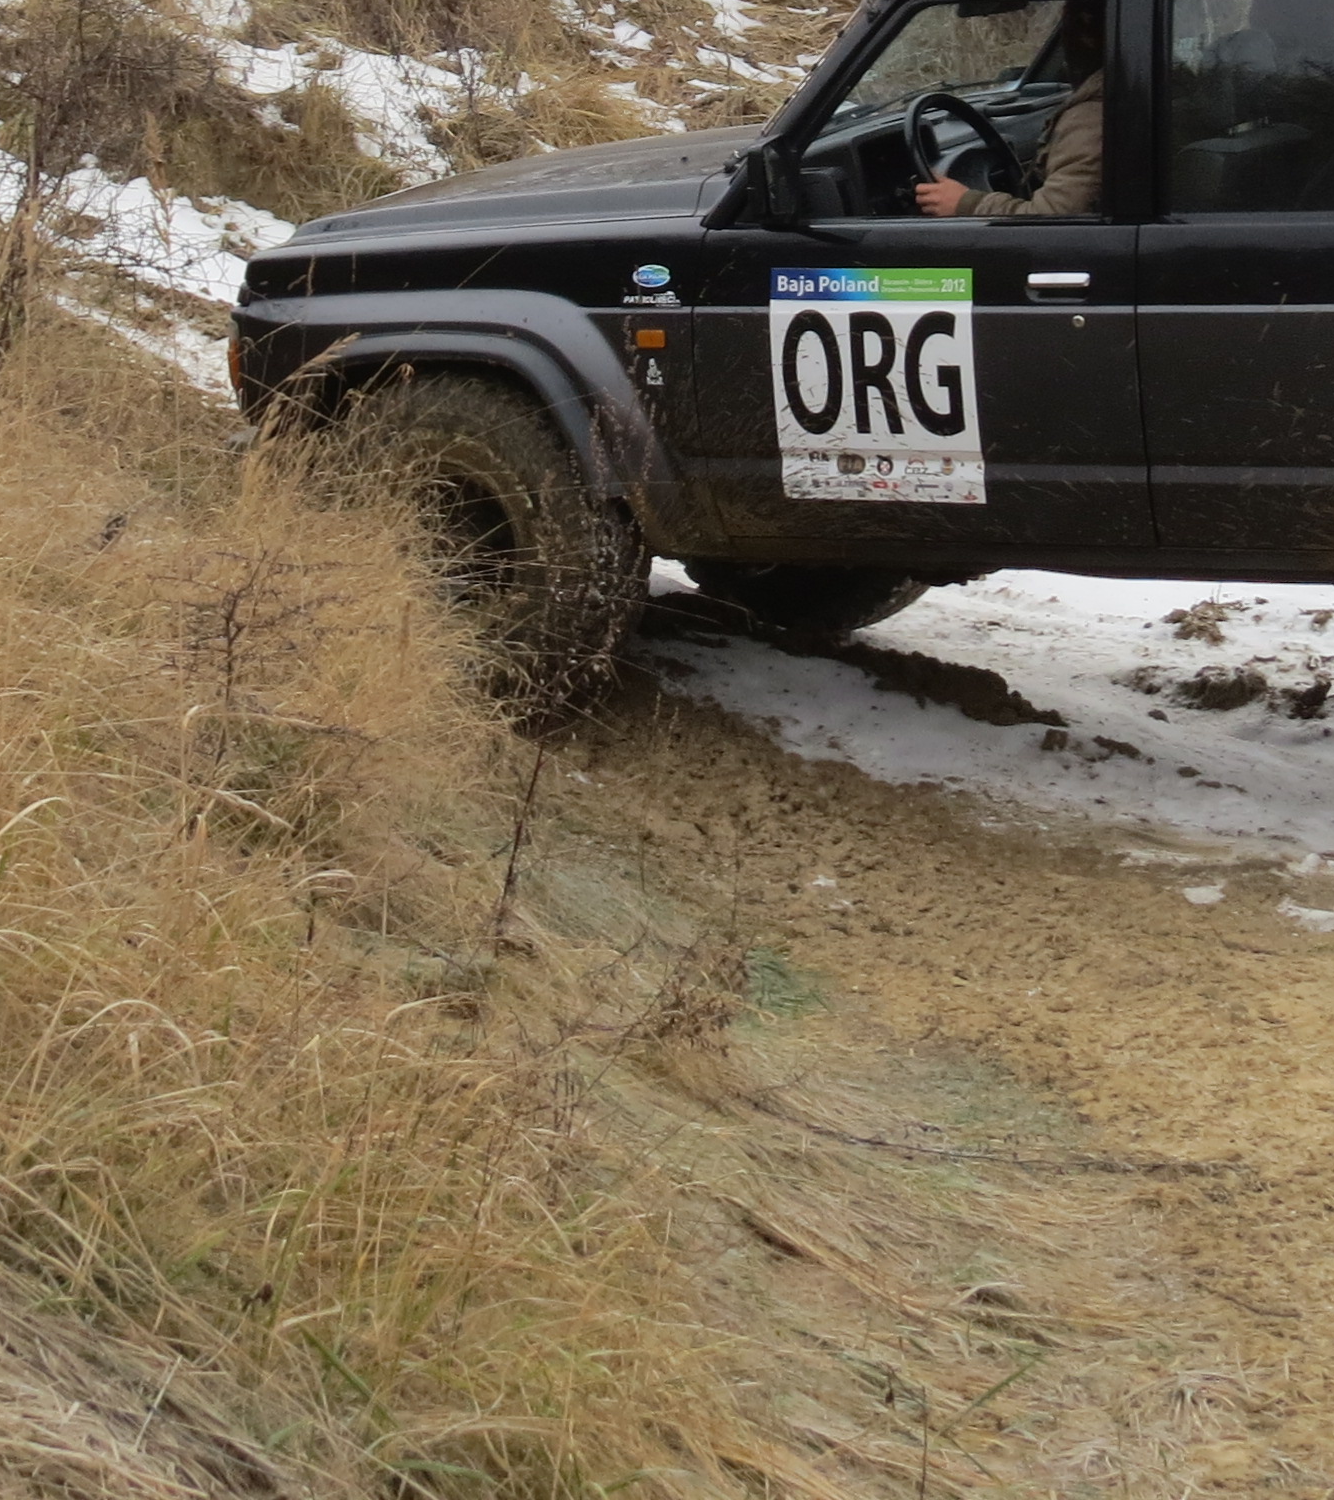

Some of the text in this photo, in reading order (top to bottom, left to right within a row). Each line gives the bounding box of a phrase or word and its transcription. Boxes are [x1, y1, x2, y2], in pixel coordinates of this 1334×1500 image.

[777, 275, 814, 296] Baja
[819, 276, 879, 293] Poland
[941, 278, 966, 293] 2012
[782, 309, 966, 437] ORG
